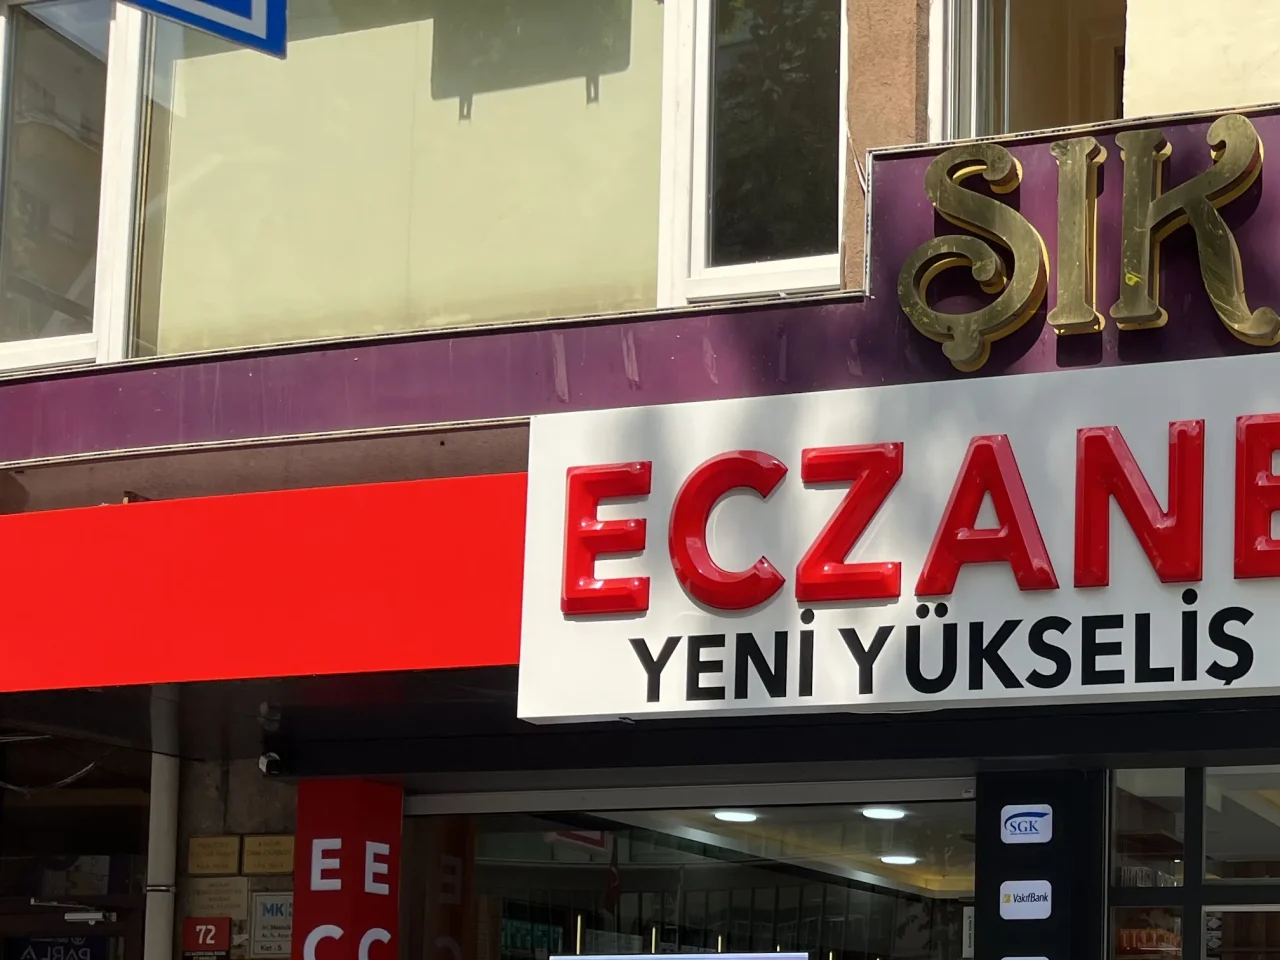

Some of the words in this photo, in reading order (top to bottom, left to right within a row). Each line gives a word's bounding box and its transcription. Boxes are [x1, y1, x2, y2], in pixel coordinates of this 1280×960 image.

[629, 609, 815, 703] YENİ
[838, 588, 1256, 695] YÜKSELİŞ
[1009, 820, 1039, 833] SGK
[262, 903, 284, 916] MK
[196, 925, 216, 944] 72
